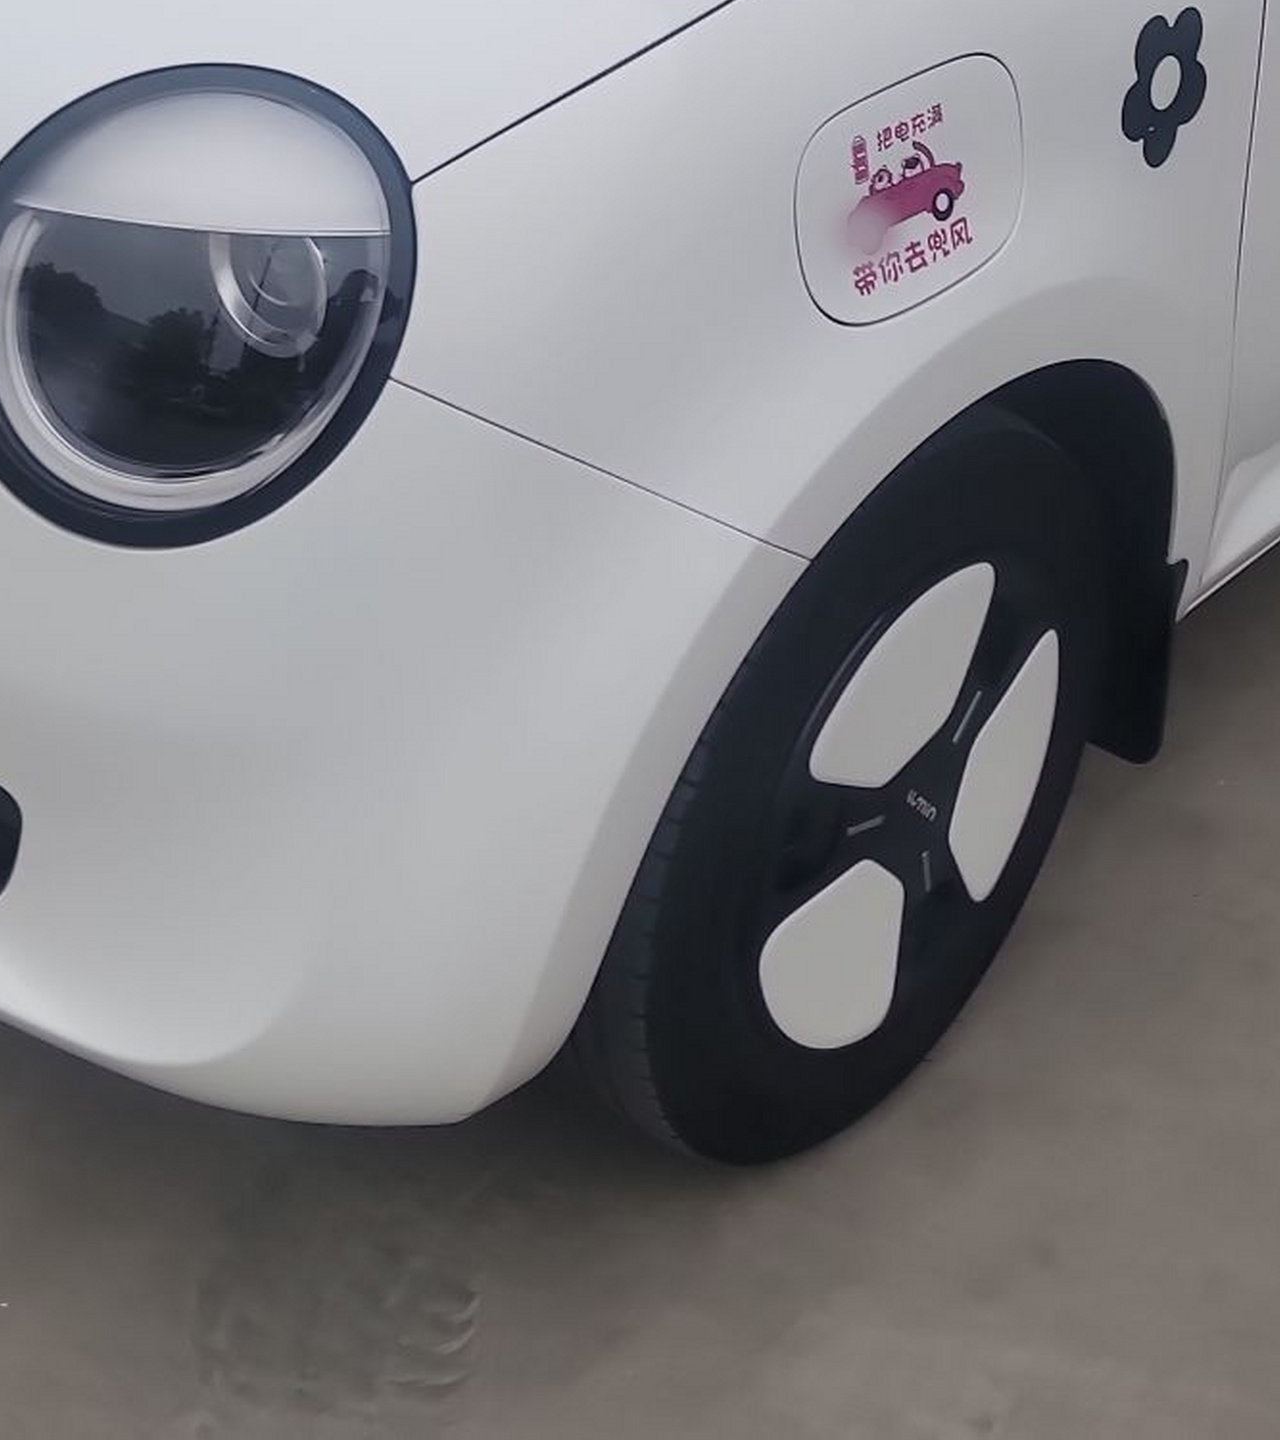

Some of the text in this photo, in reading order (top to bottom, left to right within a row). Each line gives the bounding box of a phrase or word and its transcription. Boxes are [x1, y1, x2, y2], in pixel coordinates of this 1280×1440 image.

[876, 103, 944, 152] 把电充满
[853, 216, 973, 296] 带你去兜风
